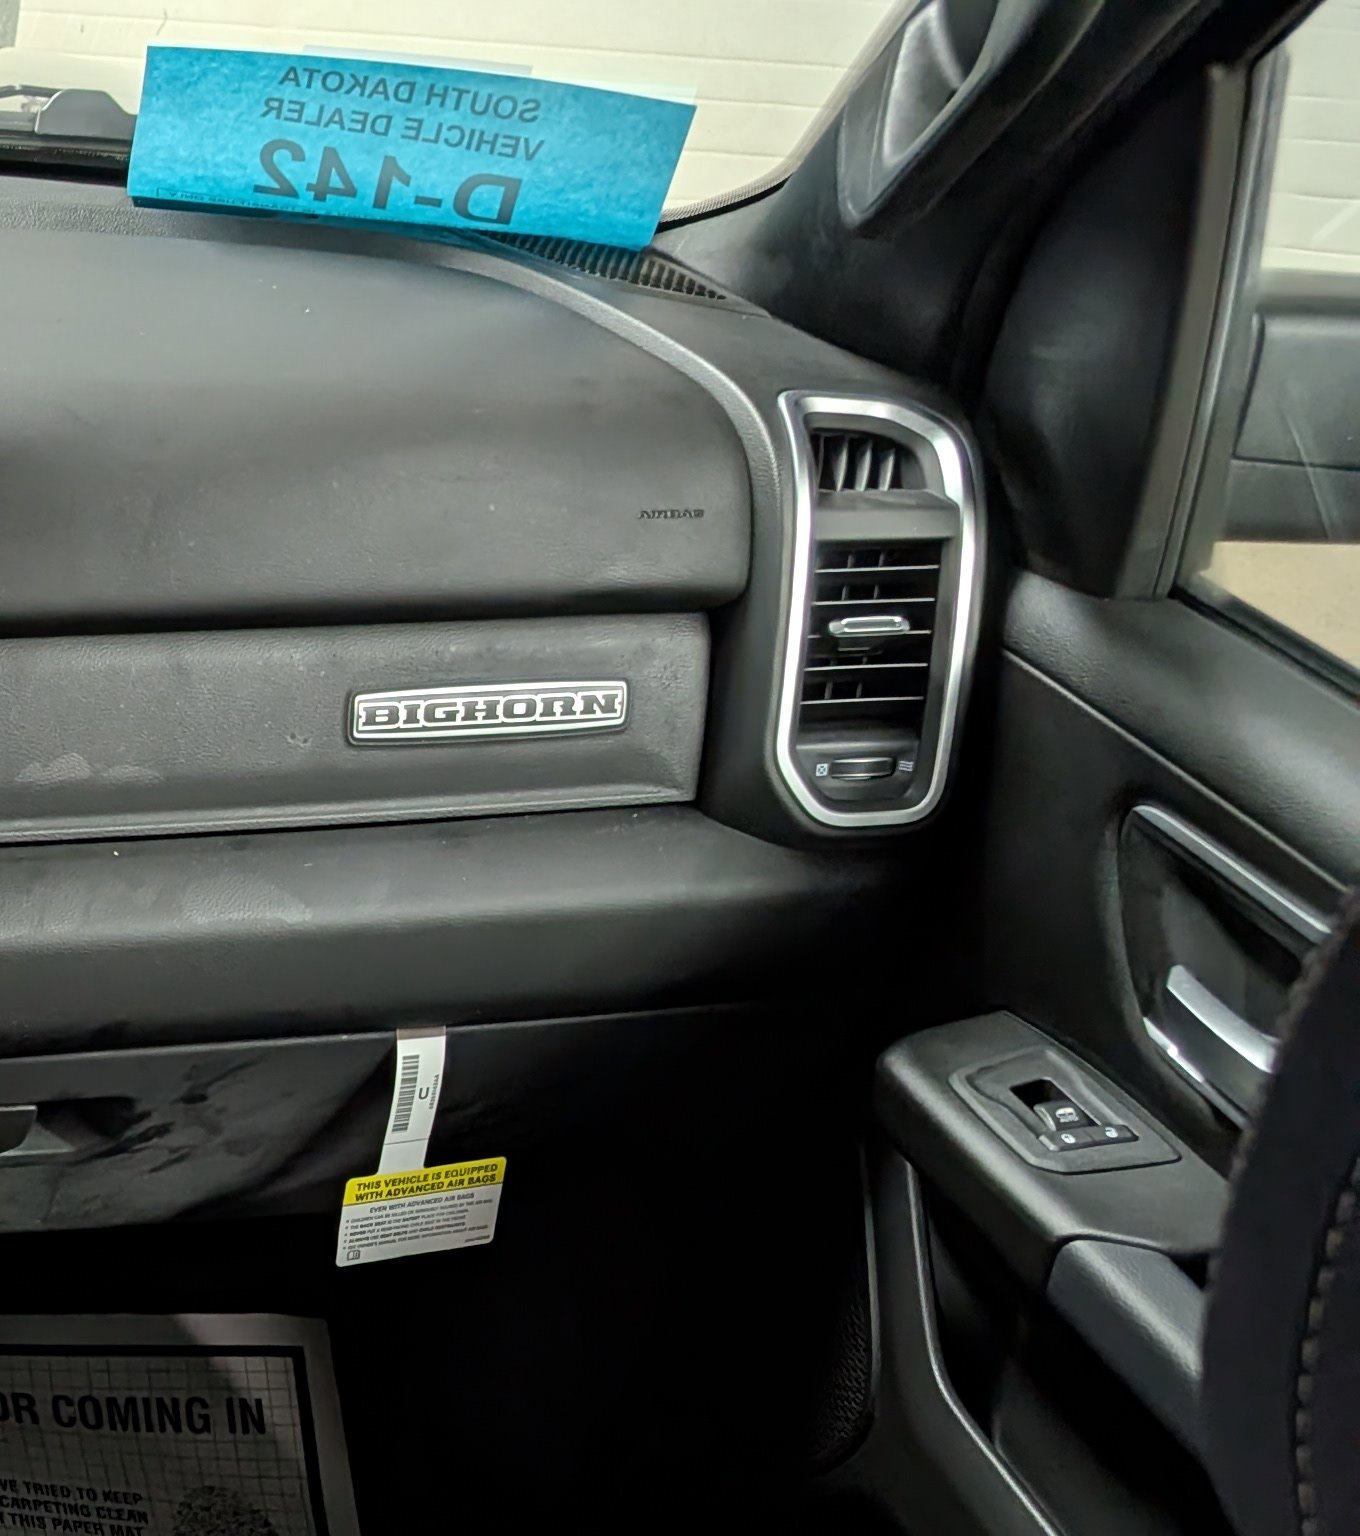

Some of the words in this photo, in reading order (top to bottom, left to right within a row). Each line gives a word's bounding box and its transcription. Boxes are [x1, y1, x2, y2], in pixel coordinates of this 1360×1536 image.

[359, 691, 622, 730] BIGHORN
[355, 1190, 383, 1202] WITH
[384, 1181, 444, 1198] ADVANCED
[446, 1178, 465, 1188] AIR
[467, 1173, 496, 1185] BAGS
[357, 1180, 382, 1192] THIS
[384, 1173, 429, 1187] VEHICLE
[432, 1171, 442, 1180] IS
[444, 1163, 499, 1179] EQUIPPED
[51, 1394, 211, 1434] COMING
[226, 1397, 266, 1435] IN
[23, 1480, 71, 1499] TRIED
[76, 1487, 97, 1501] TO
[102, 1489, 143, 1505] KEEP
[0, 1495, 91, 1518] CARPETING
[95, 1505, 149, 1524] CLEAN
[8, 1512, 47, 1530] THIS
[52, 1517, 105, 1536] PAPER
